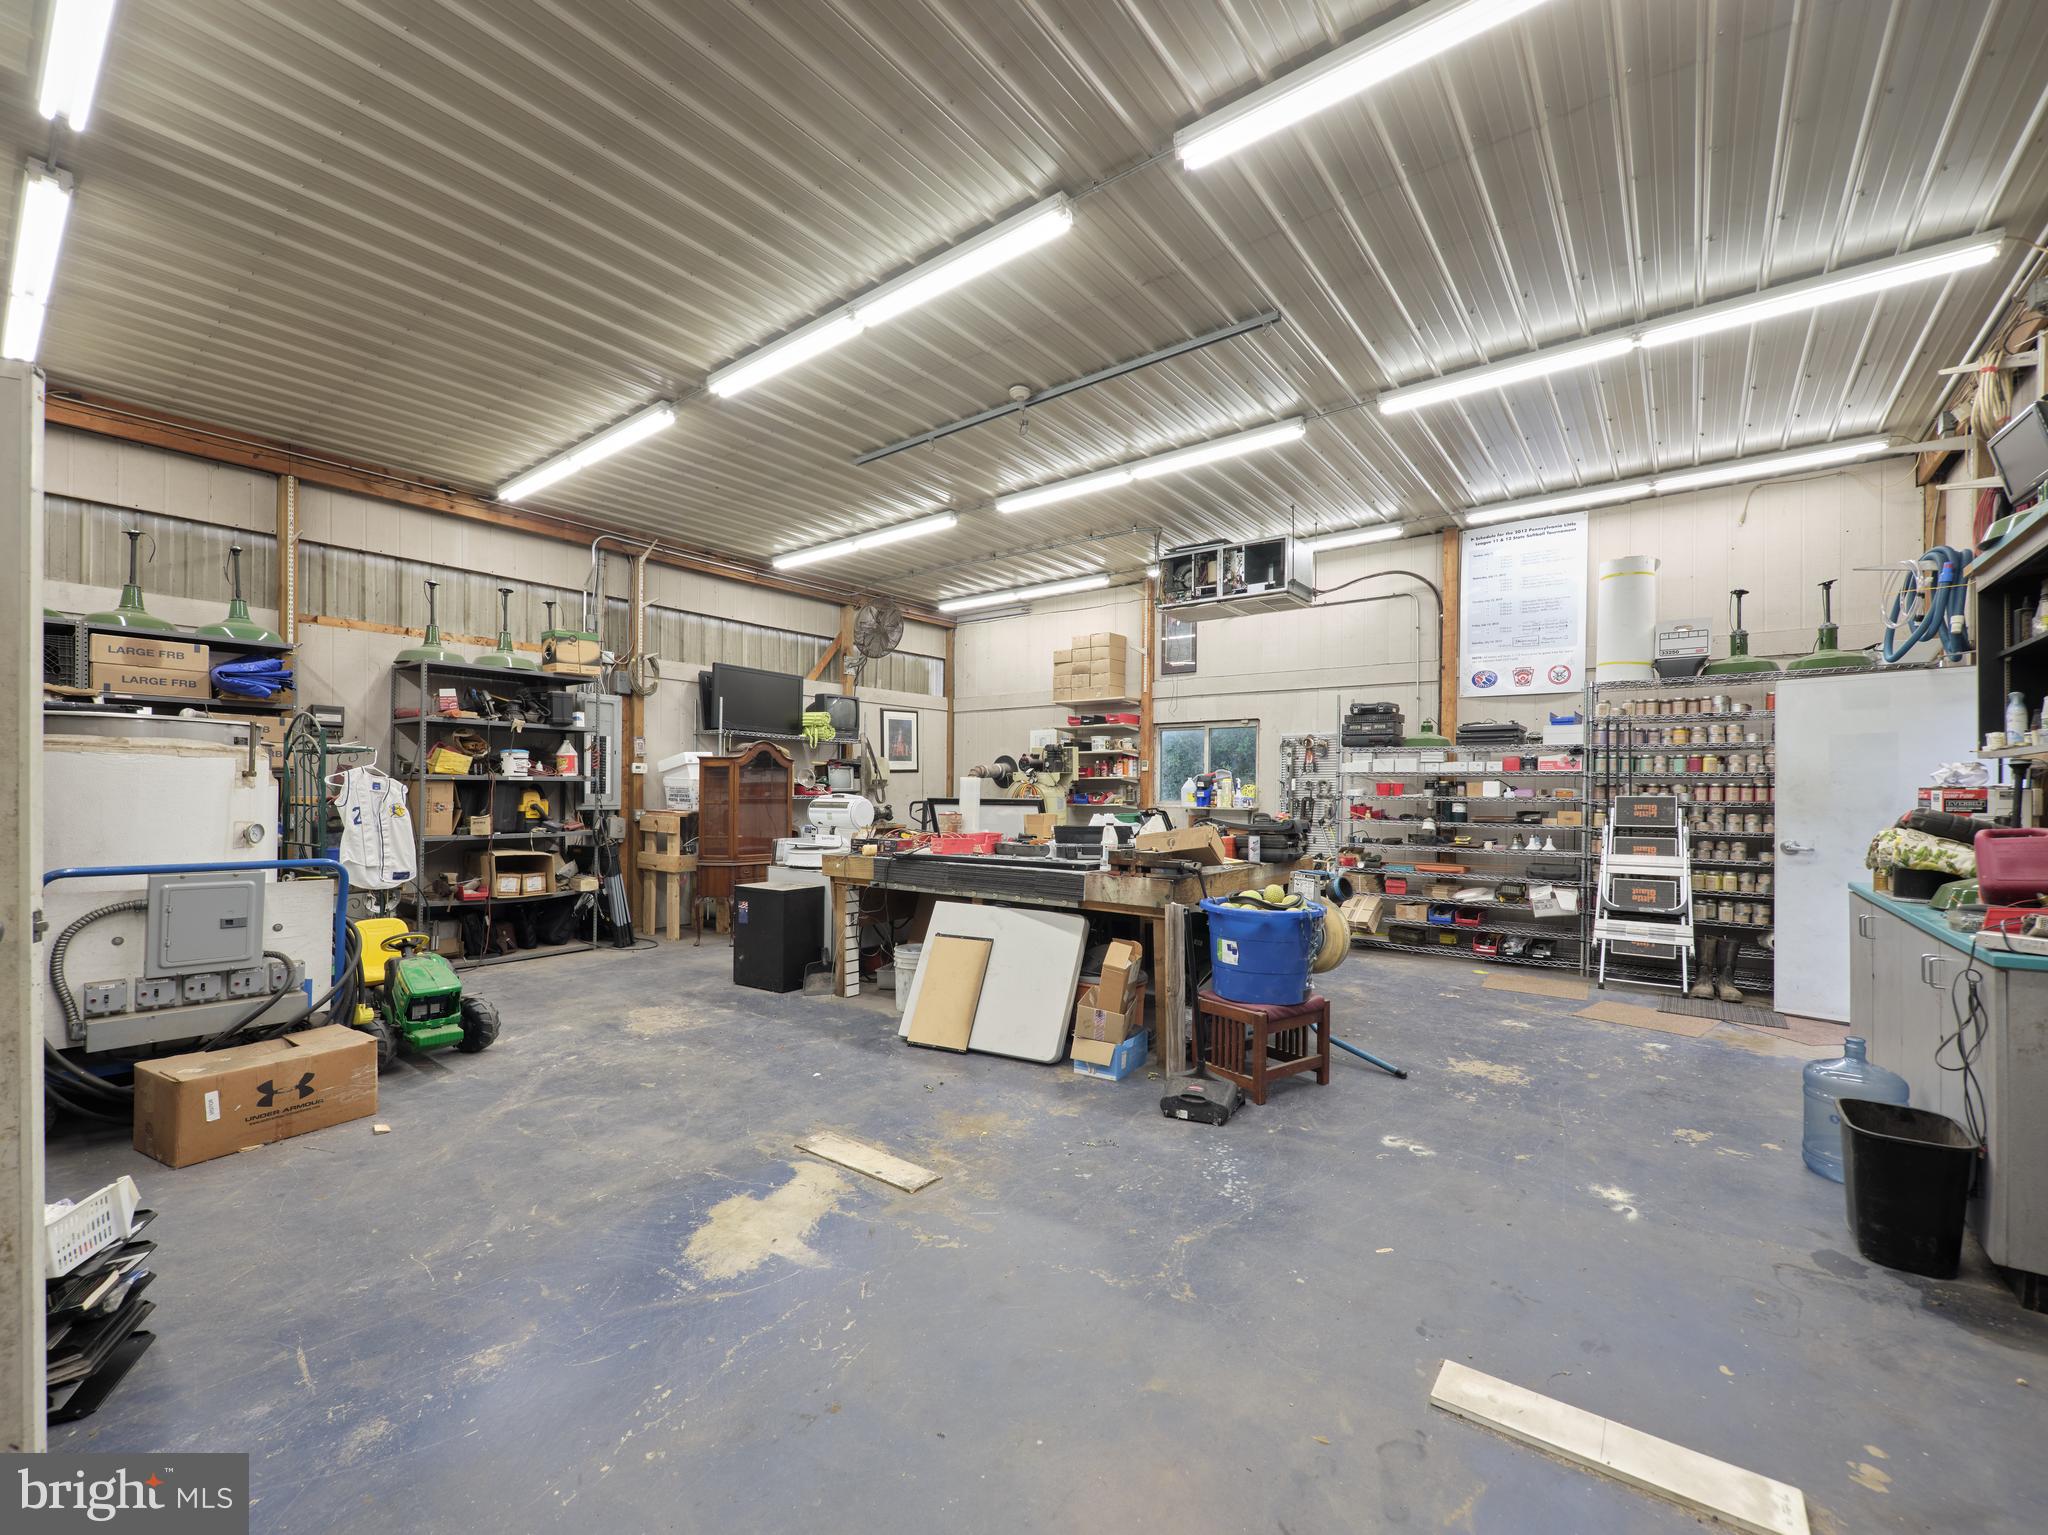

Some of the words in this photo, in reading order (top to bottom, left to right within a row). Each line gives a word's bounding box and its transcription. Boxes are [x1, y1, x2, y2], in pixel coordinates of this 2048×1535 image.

[1475, 533, 1496, 541] Schedule
[1528, 523, 1563, 532] Pennsylvania
[1546, 527, 1577, 535] Tournament
[107, 644, 156, 657] LARGE
[158, 649, 186, 660] FRB
[121, 674, 168, 687] LARGE
[171, 678, 198, 689] FRB
[352, 806, 363, 825] 2
[245, 1109, 280, 1122] UNDER
[282, 1098, 325, 1113] ARMOUR
